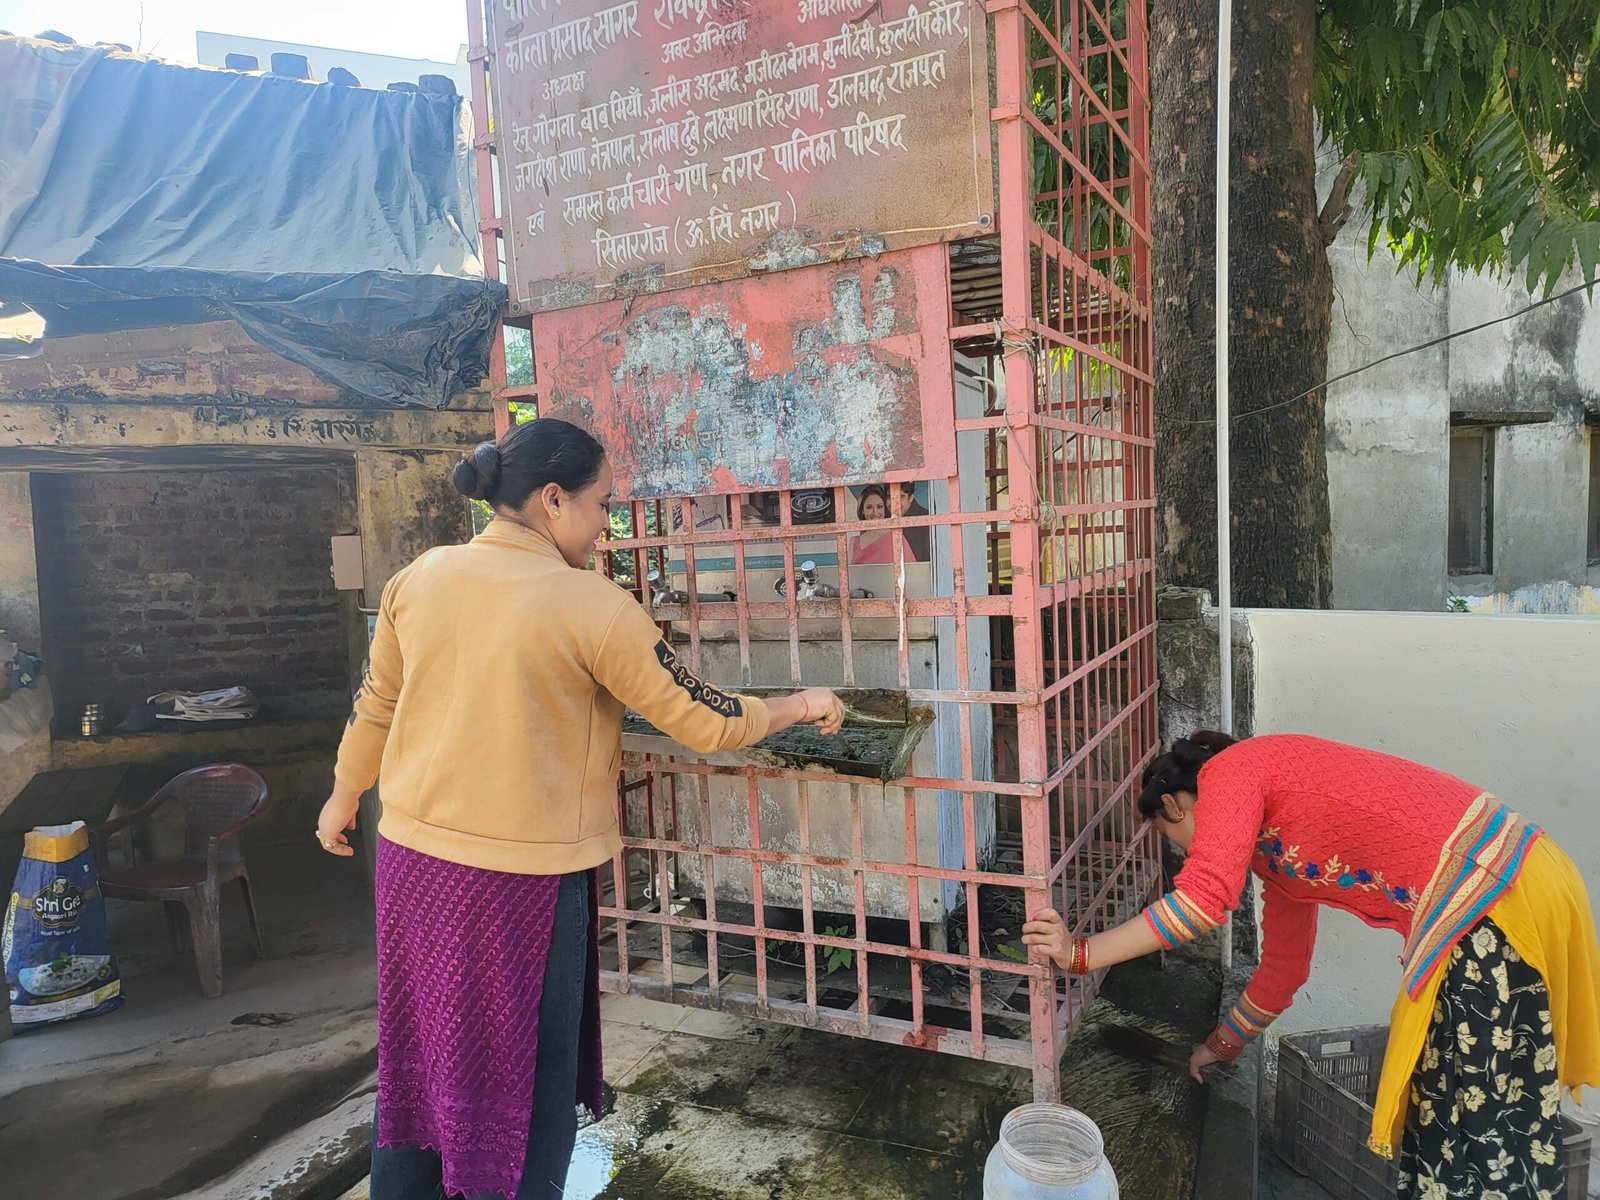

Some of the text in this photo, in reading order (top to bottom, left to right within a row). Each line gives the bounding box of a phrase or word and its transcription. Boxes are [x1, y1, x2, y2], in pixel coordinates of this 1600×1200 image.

[547, 17, 597, 64] प्रसाद
[593, 1, 642, 50] सागर
[661, 37, 694, 64] अवर
[542, 70, 587, 101] अध्यक्ष
[562, 191, 605, 227] समस्त
[721, 147, 770, 186] नगर
[590, 222, 670, 271] सितारगंज
[36, 897, 59, 912] Shri
